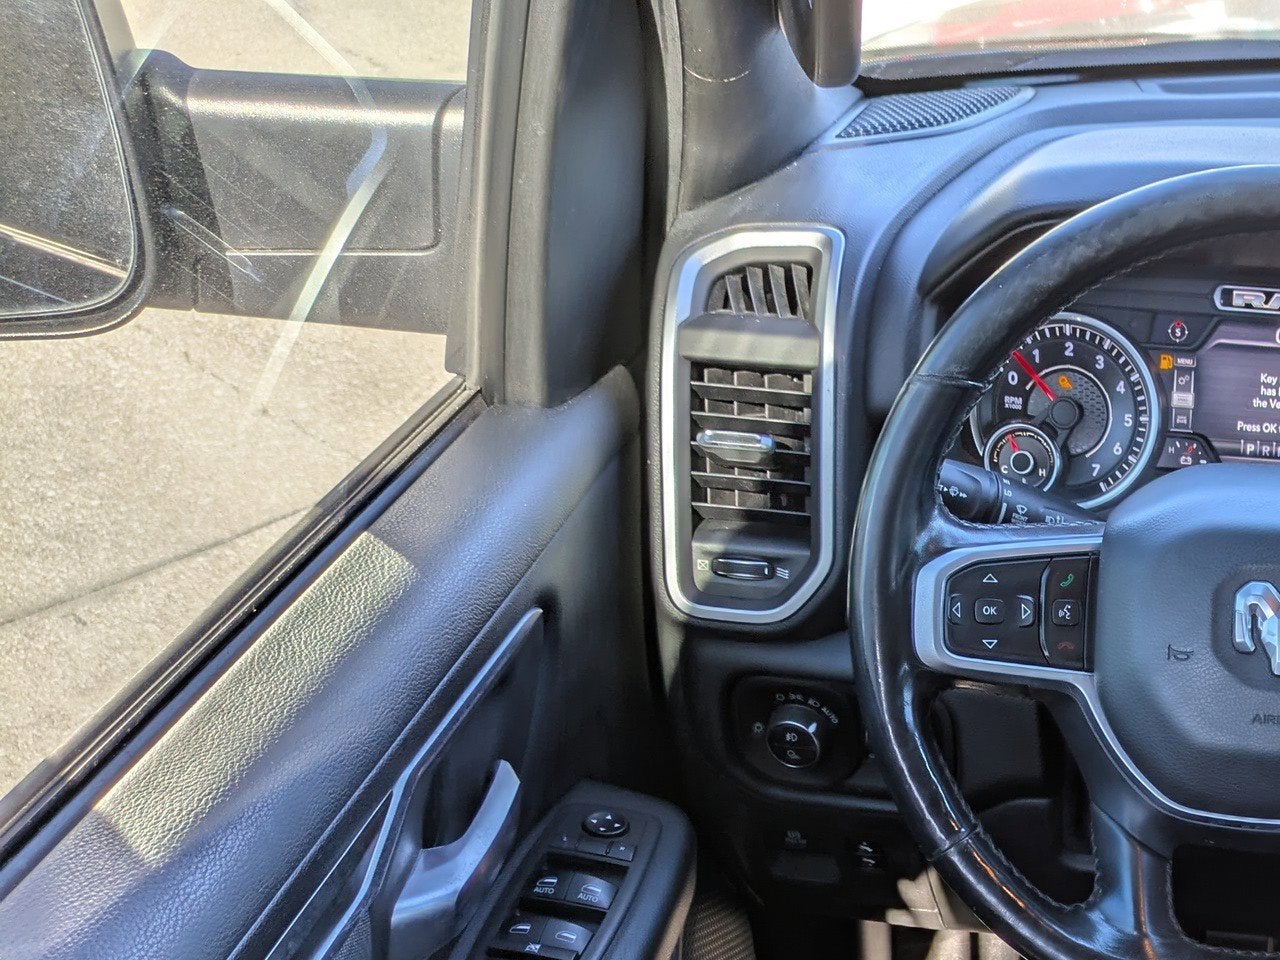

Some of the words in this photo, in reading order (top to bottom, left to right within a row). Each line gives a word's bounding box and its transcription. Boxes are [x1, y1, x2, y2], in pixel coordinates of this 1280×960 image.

[1175, 328, 1182, 337] S
[1065, 341, 1074, 357] 2
[1032, 348, 1040, 363] 1
[1095, 354, 1105, 370] 3
[1007, 371, 1018, 385] 0
[1261, 373, 1278, 386] Key
[1116, 380, 1125, 394] 4
[1261, 386, 1276, 397] has
[1004, 395, 1023, 405] RPM
[1253, 398, 1267, 409] the
[1124, 413, 1133, 428] 5
[1237, 421, 1261, 433] Press
[1262, 422, 1278, 434] OK
[1113, 442, 1122, 455] 6
[1246, 444, 1255, 455] P
[1262, 445, 1270, 456] R
[1000, 465, 1009, 474] C
[1038, 468, 1046, 477] H
[1092, 464, 1101, 477] 7
[982, 605, 997, 616] OK
[533, 887, 555, 895] AUTO
[577, 892, 599, 903] AUTO
